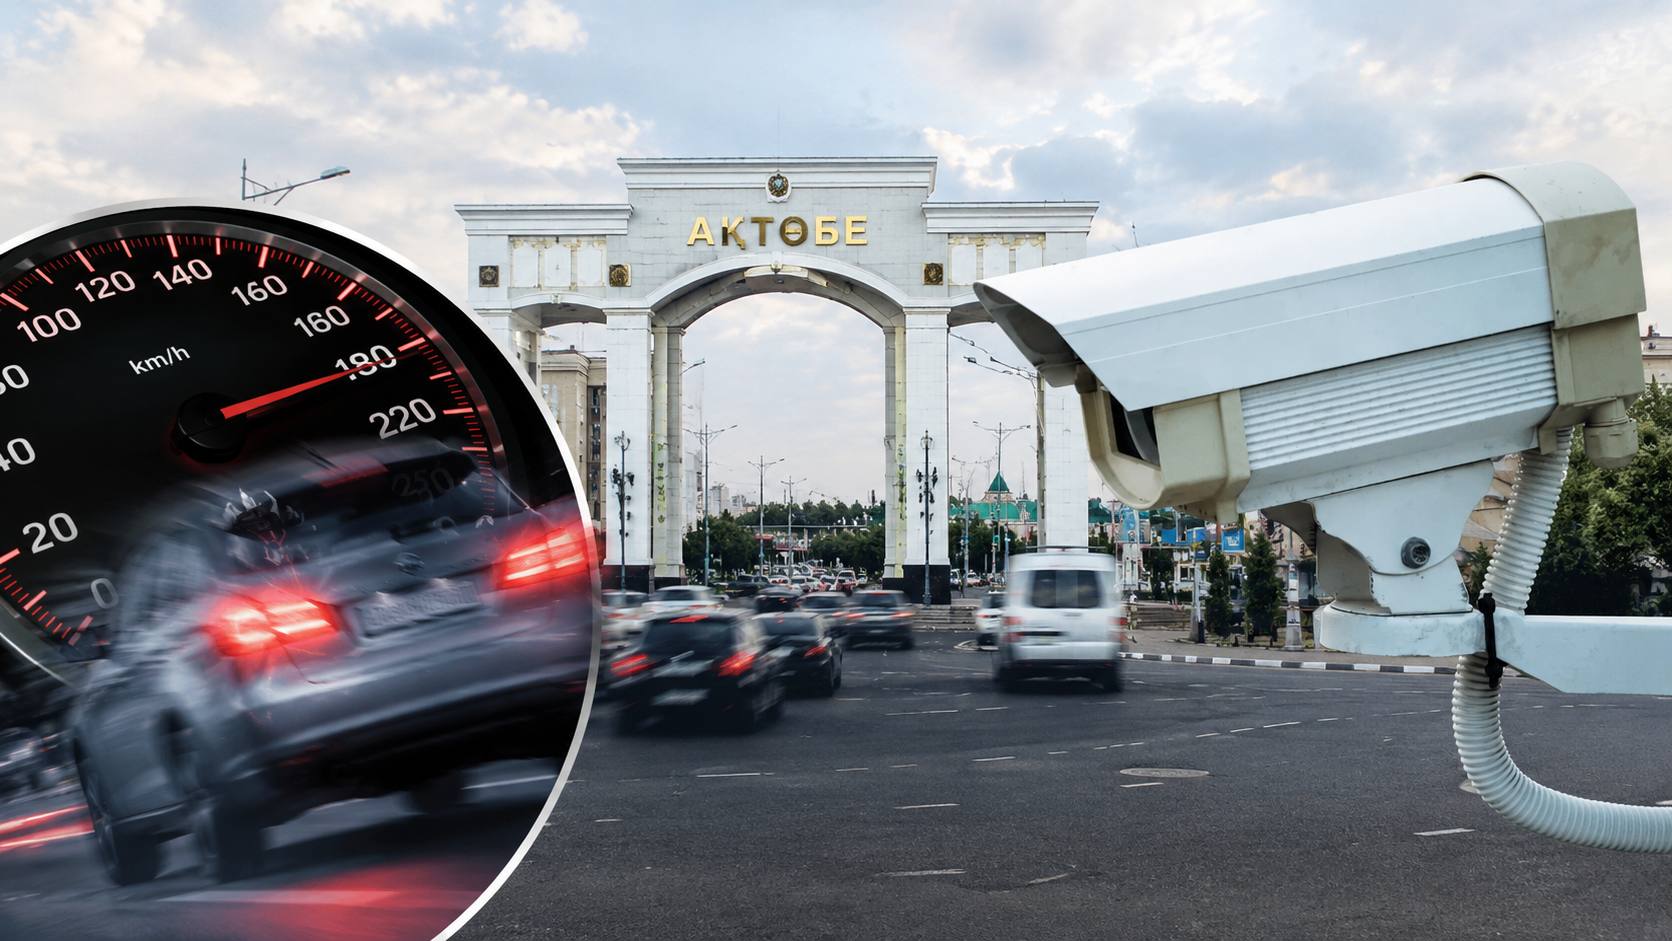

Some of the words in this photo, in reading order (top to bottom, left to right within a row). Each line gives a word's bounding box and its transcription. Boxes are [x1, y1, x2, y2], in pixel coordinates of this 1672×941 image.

[687, 215, 868, 250] АҚТӨБЕ
[75, 271, 136, 302] 120
[153, 259, 213, 291] 140
[231, 275, 288, 306] 160
[17, 308, 82, 342] 100
[294, 305, 350, 337] 160
[129, 346, 190, 375] km/h
[335, 345, 397, 381] 180
[0, 364, 30, 395] 0
[369, 398, 437, 440] 220
[22, 512, 79, 554] 20
[90, 578, 119, 609] 0
